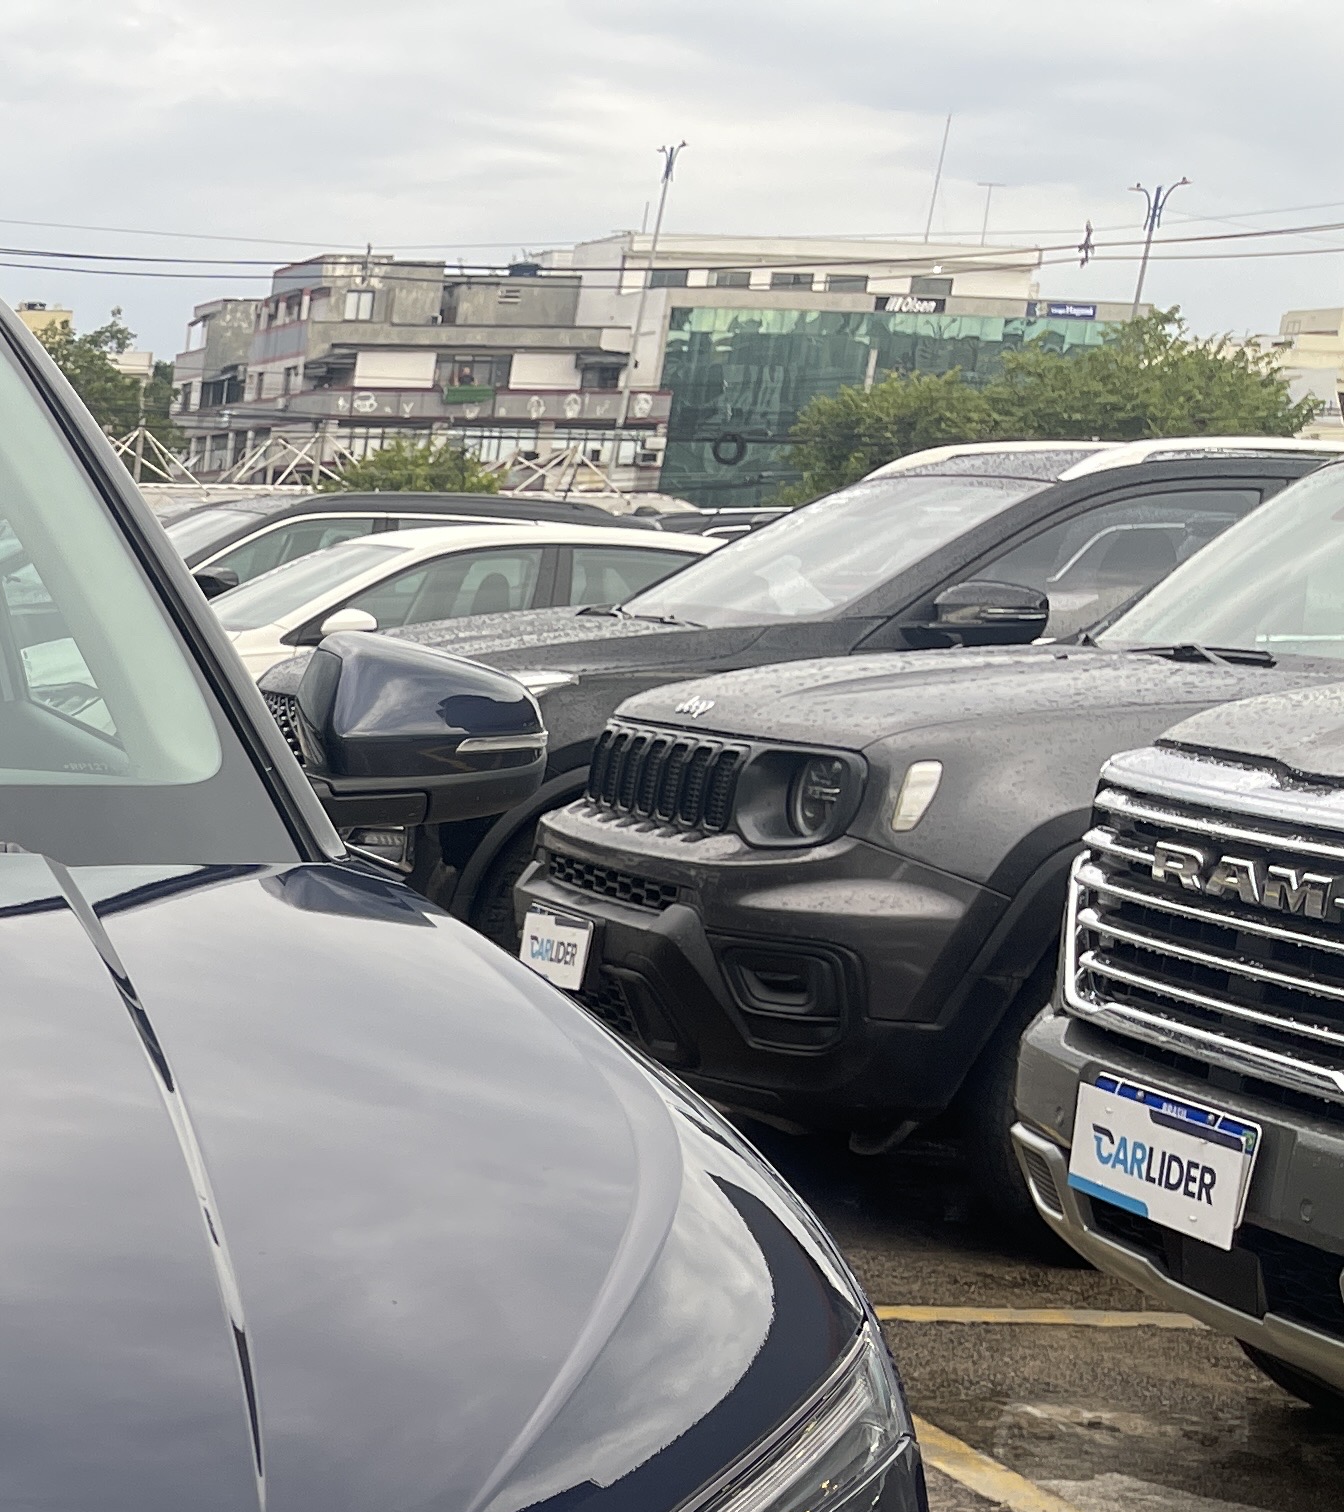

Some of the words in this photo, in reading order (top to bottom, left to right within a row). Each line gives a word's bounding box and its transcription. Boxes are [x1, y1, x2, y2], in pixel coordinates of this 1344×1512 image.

[1151, 840, 1334, 920] RAM
[530, 934, 578, 967] CARLIDER
[1092, 1123, 1217, 1206] CARLIDER
